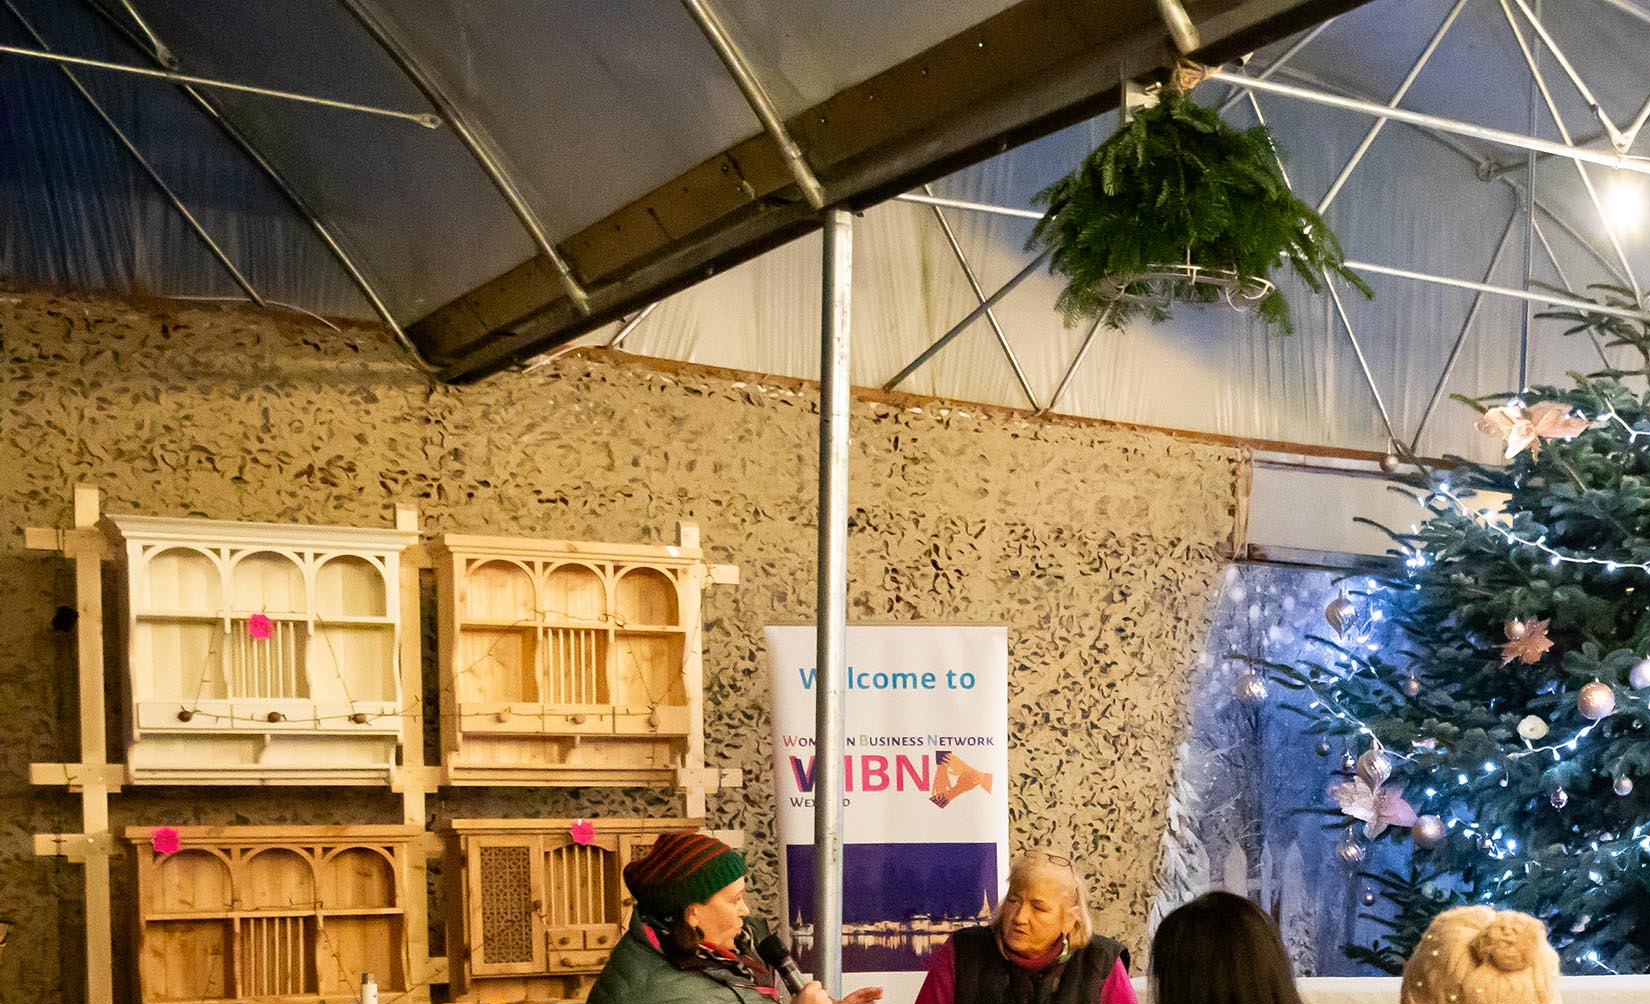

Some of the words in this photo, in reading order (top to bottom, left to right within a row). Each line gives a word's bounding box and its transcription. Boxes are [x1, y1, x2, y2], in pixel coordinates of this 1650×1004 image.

[799, 666, 936, 690] Wlcome
[946, 669, 976, 690] to
[859, 734, 924, 747] BUSINESS
[927, 734, 995, 747] NETWORK
